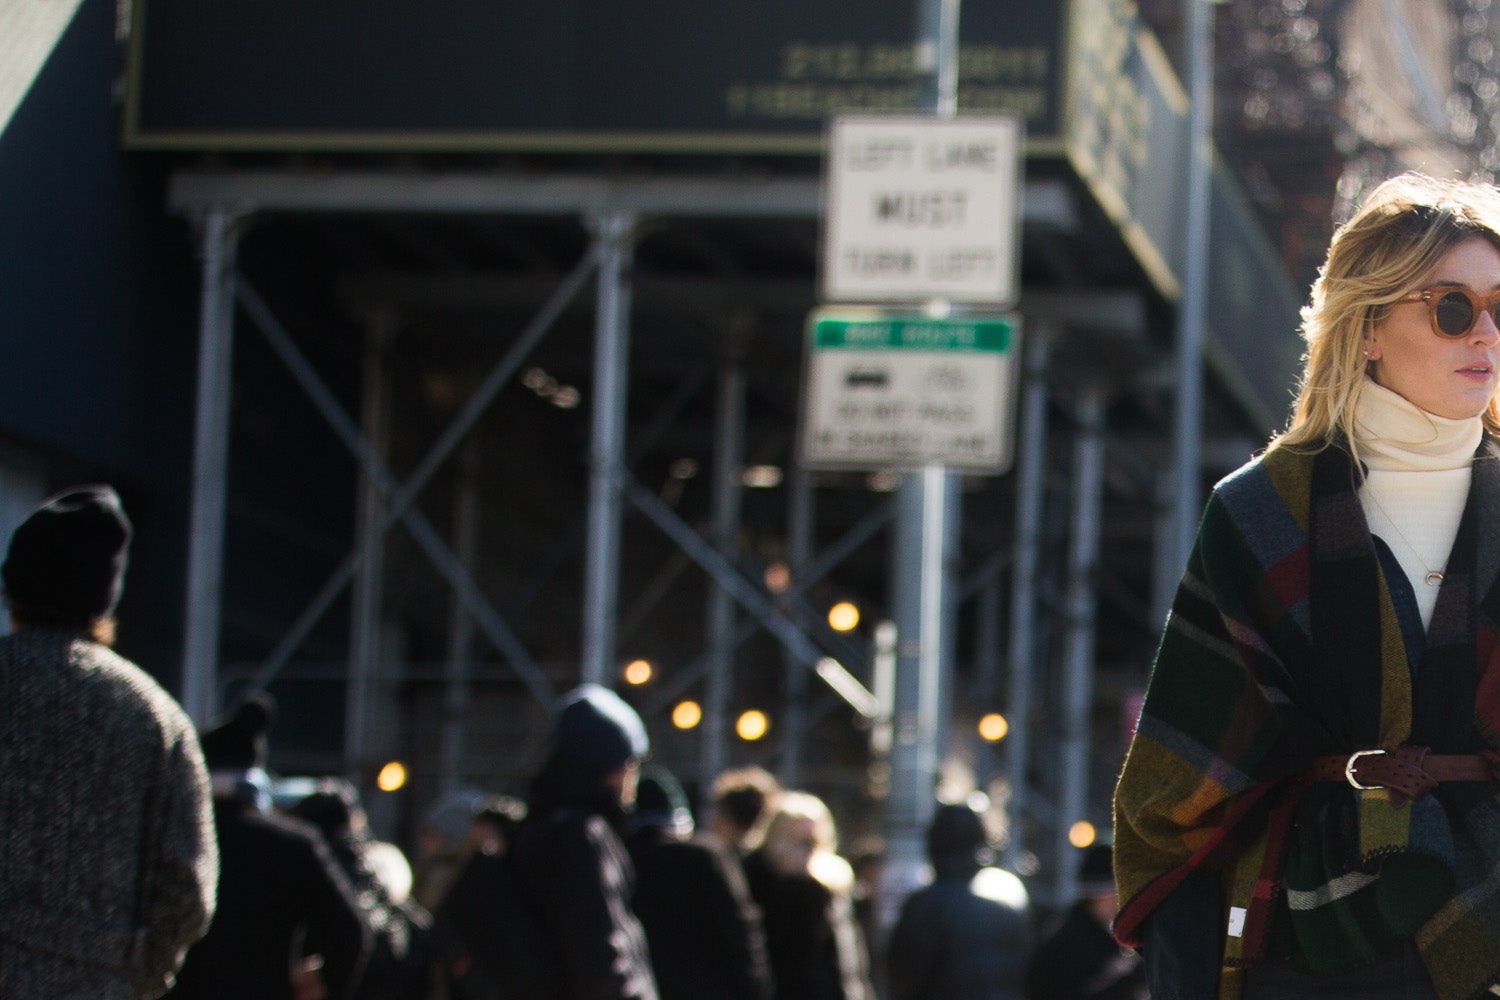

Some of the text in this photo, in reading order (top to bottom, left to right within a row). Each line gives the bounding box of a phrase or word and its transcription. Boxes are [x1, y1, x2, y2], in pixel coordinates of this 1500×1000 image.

[845, 140, 914, 171] LEFT
[874, 191, 969, 227] MUST
[927, 247, 997, 278] LEFT
